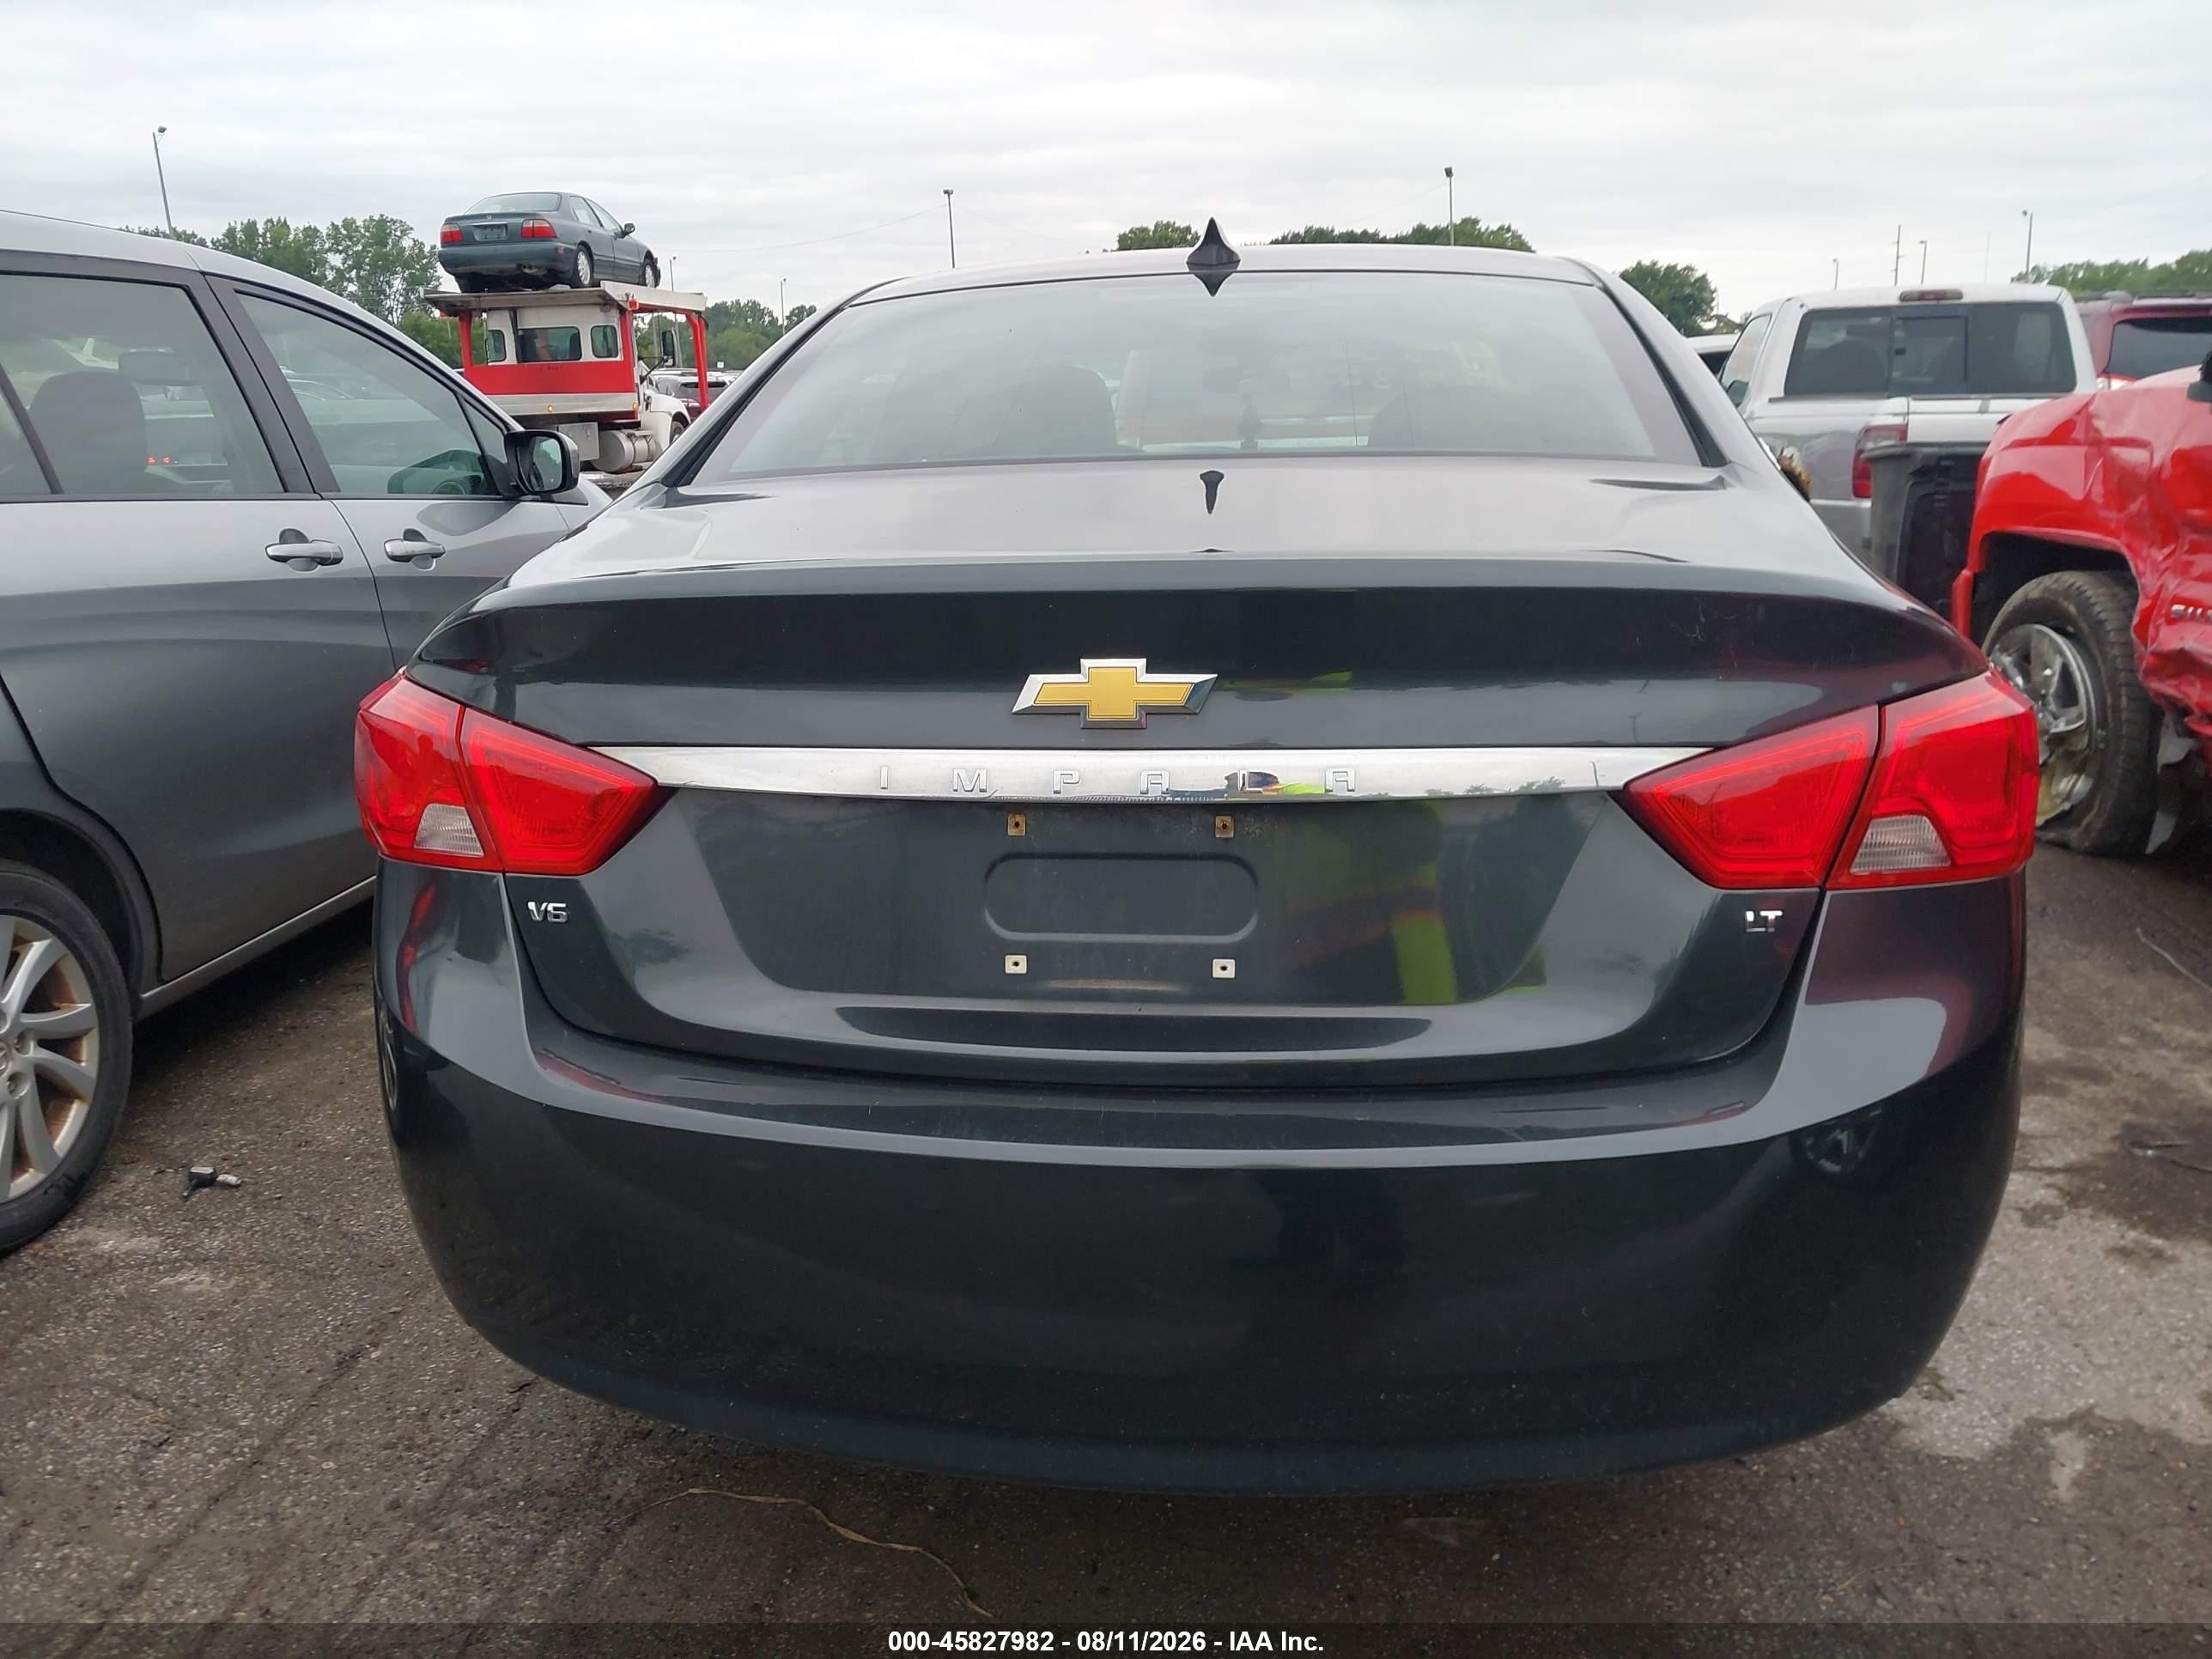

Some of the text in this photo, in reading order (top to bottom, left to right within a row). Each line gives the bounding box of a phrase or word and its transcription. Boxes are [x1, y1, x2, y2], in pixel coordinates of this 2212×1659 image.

[879, 766, 1356, 796] IMPALA
[527, 901, 568, 923] V6
[1745, 910, 1784, 933] LT
